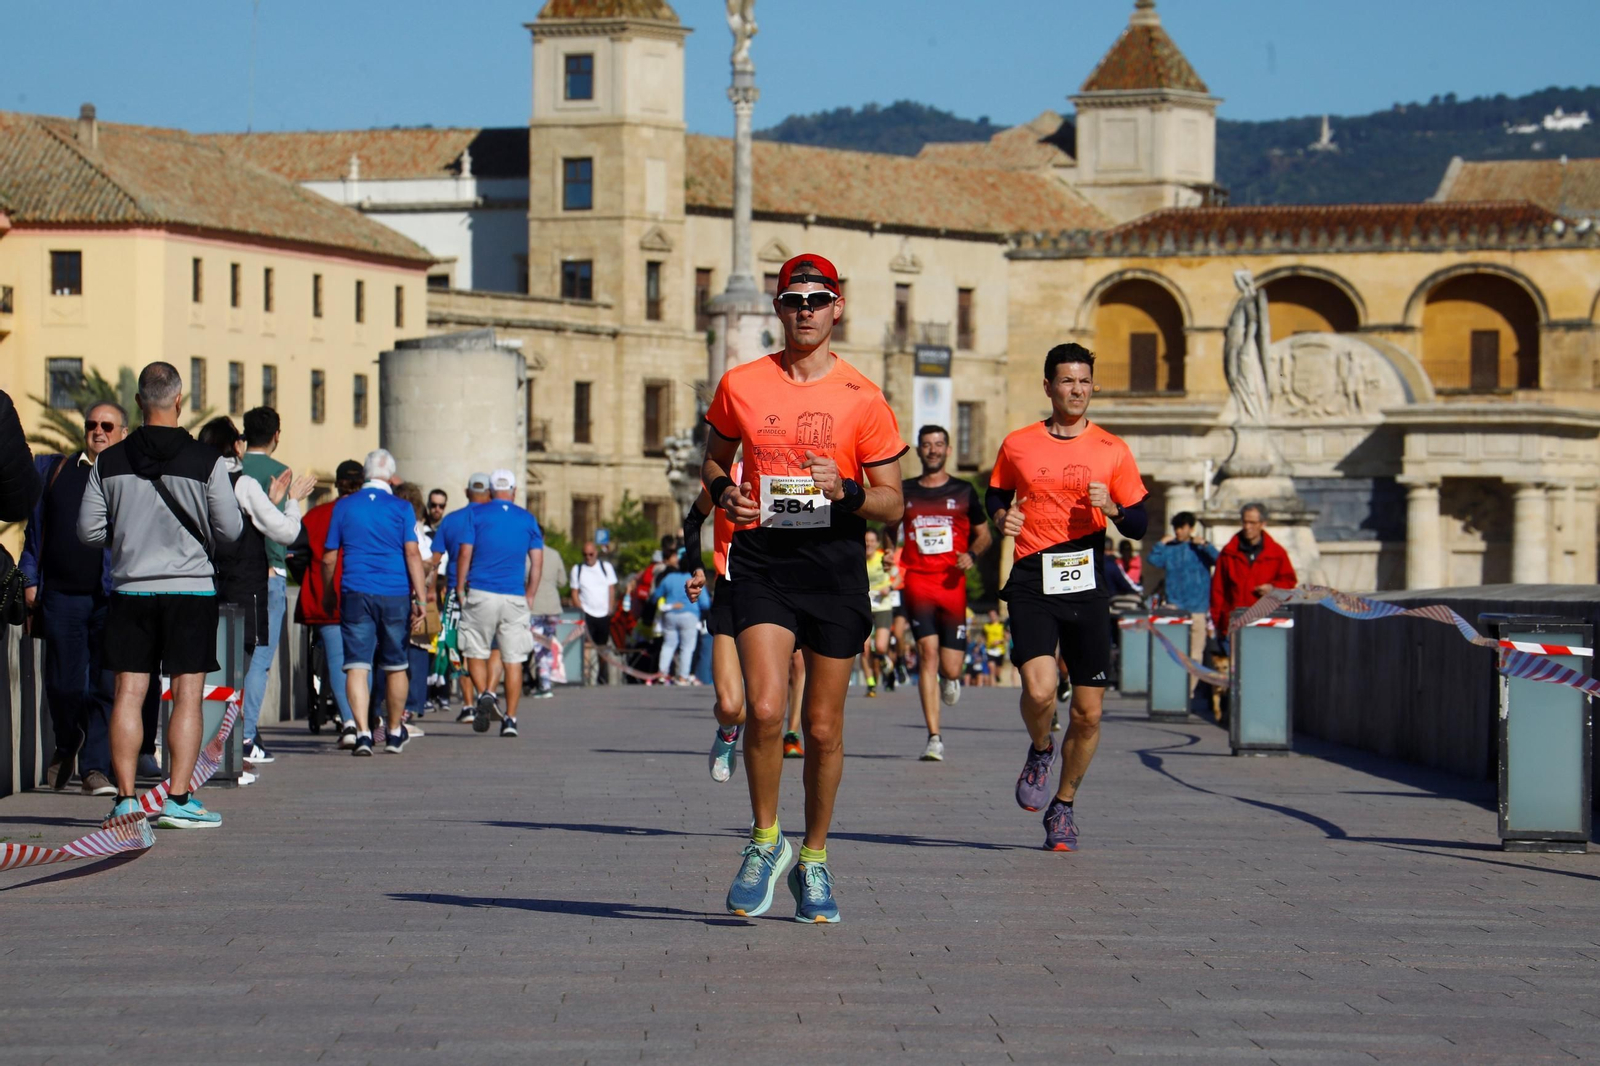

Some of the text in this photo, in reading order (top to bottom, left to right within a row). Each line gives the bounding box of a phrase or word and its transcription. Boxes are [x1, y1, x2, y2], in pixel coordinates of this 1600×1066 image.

[773, 499, 815, 514] 584
[924, 538, 944, 547] 574
[1060, 569, 1081, 582] 20
